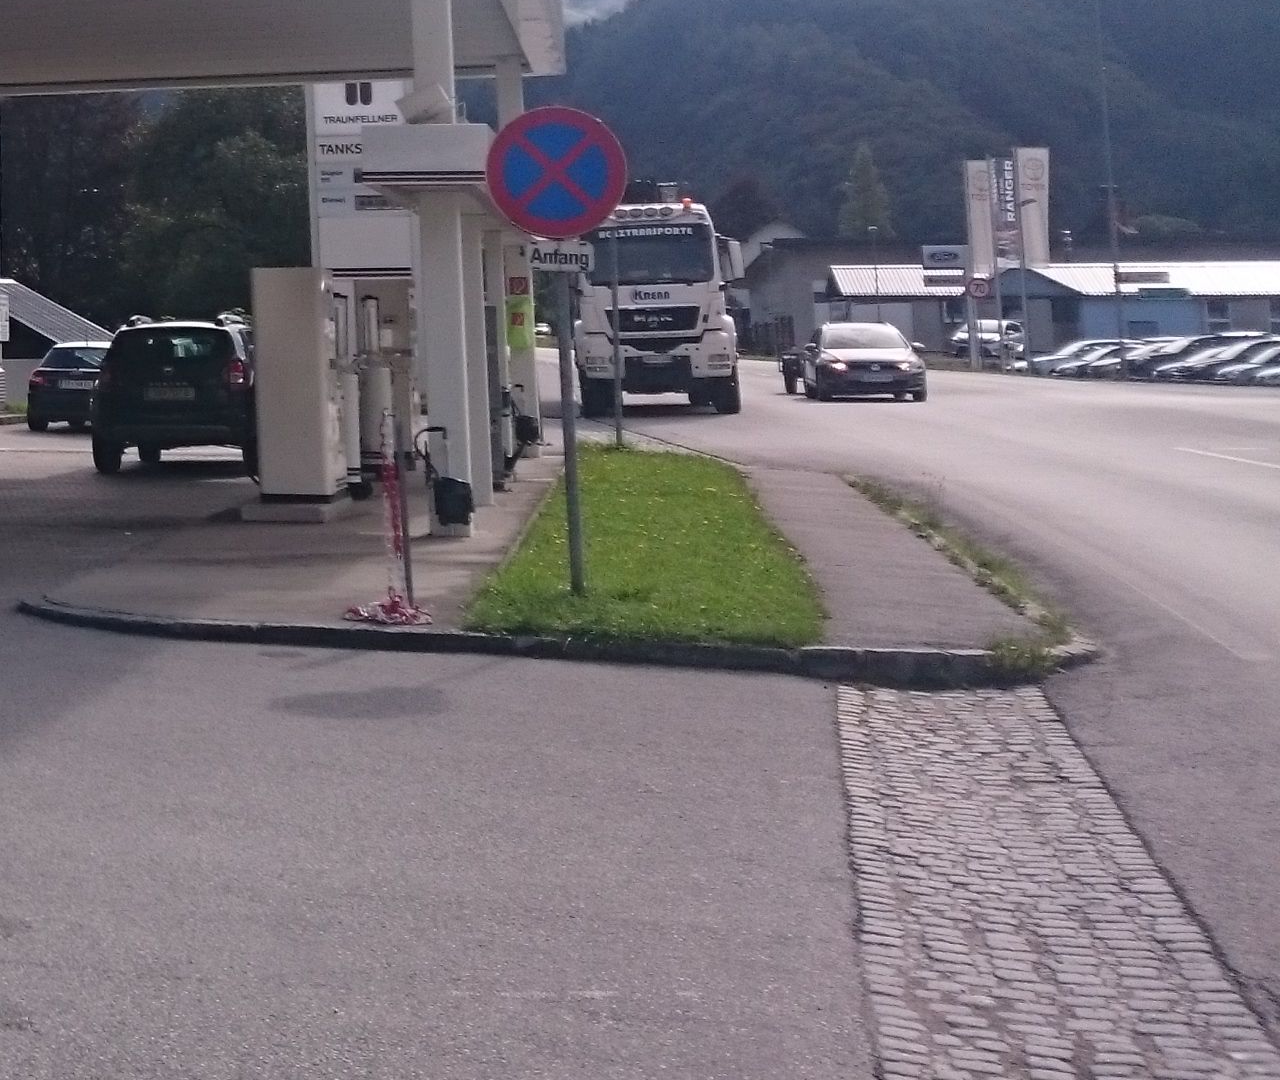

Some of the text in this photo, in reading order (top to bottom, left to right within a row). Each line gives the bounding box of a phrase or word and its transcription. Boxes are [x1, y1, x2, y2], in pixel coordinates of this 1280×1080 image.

[323, 114, 398, 125] TRAUNFELLNER
[1004, 160, 1016, 222] RANGER
[530, 247, 590, 271] Anfang
[973, 283, 985, 294] 70
